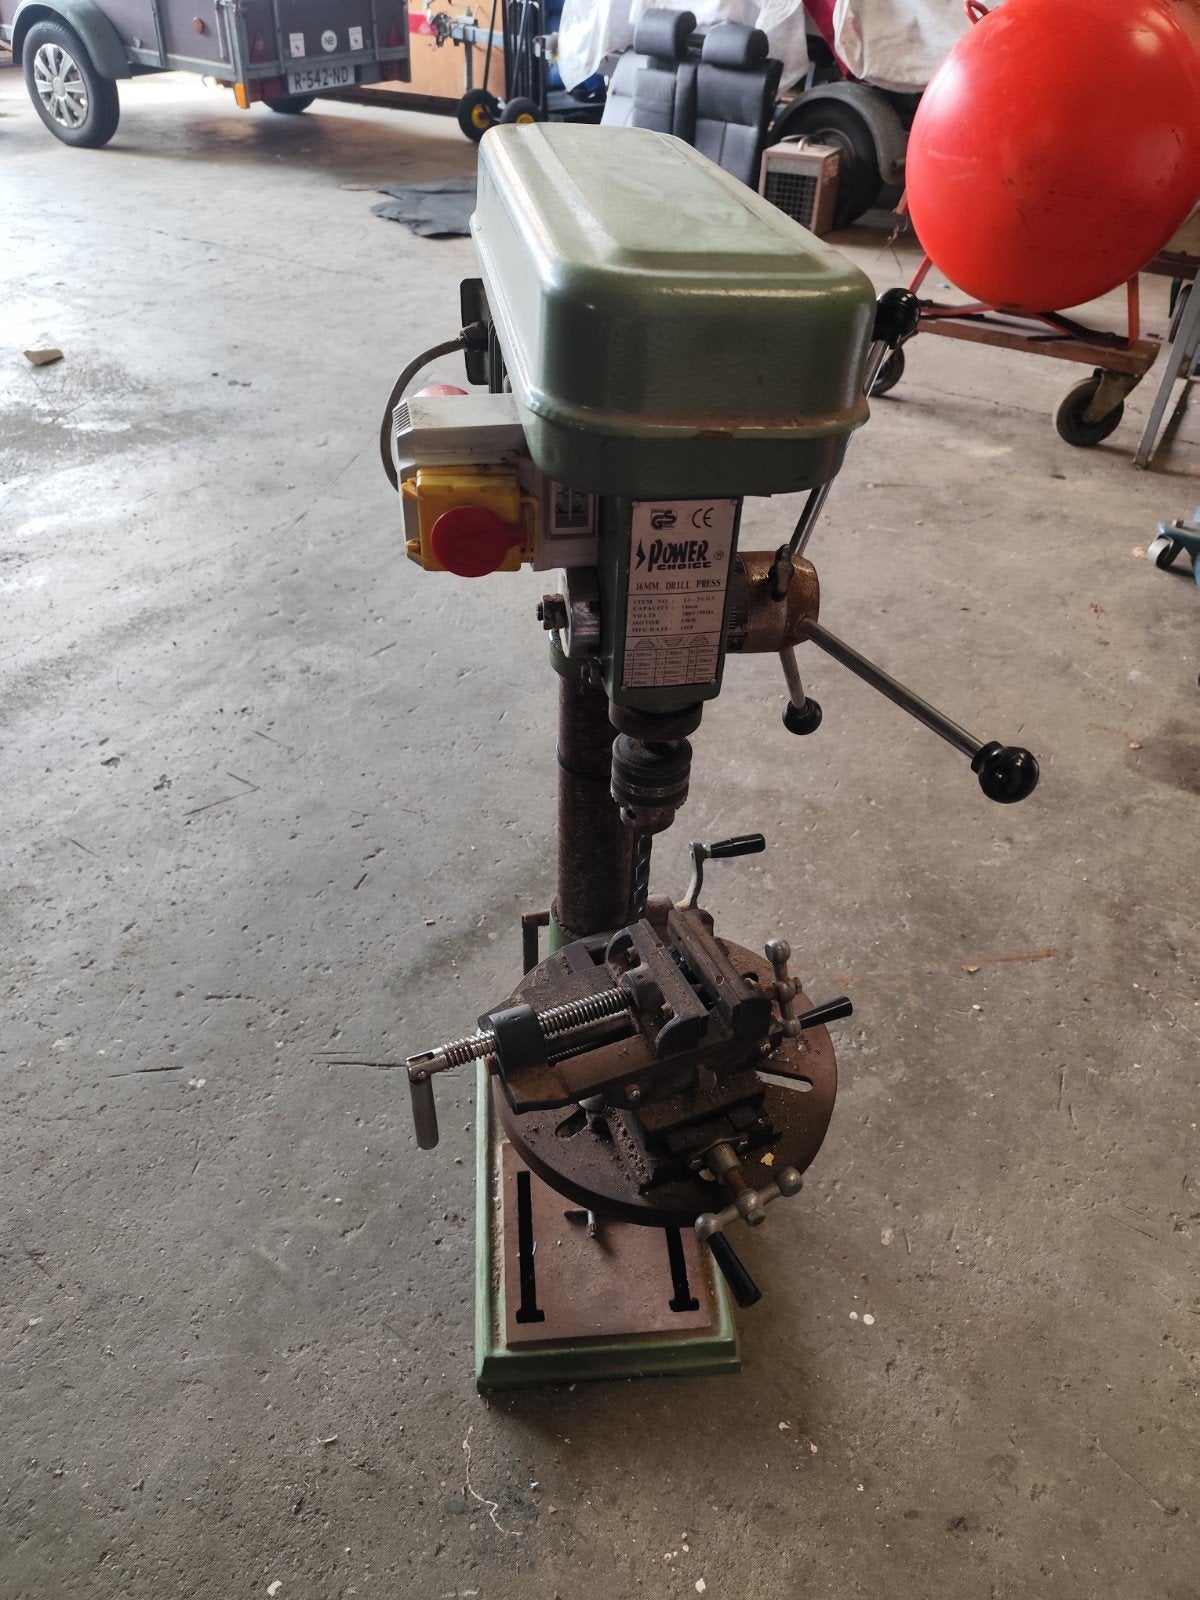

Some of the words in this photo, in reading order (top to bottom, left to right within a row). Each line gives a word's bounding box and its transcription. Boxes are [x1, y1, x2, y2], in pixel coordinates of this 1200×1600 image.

[294, 66, 349, 91] R-542-ND
[691, 507, 714, 529] CE
[647, 538, 709, 573] POWER
[657, 561, 712, 571] CHOICE
[635, 581, 659, 591] 16MM
[665, 580, 691, 590] DRILL
[696, 578, 721, 588] PRESS
